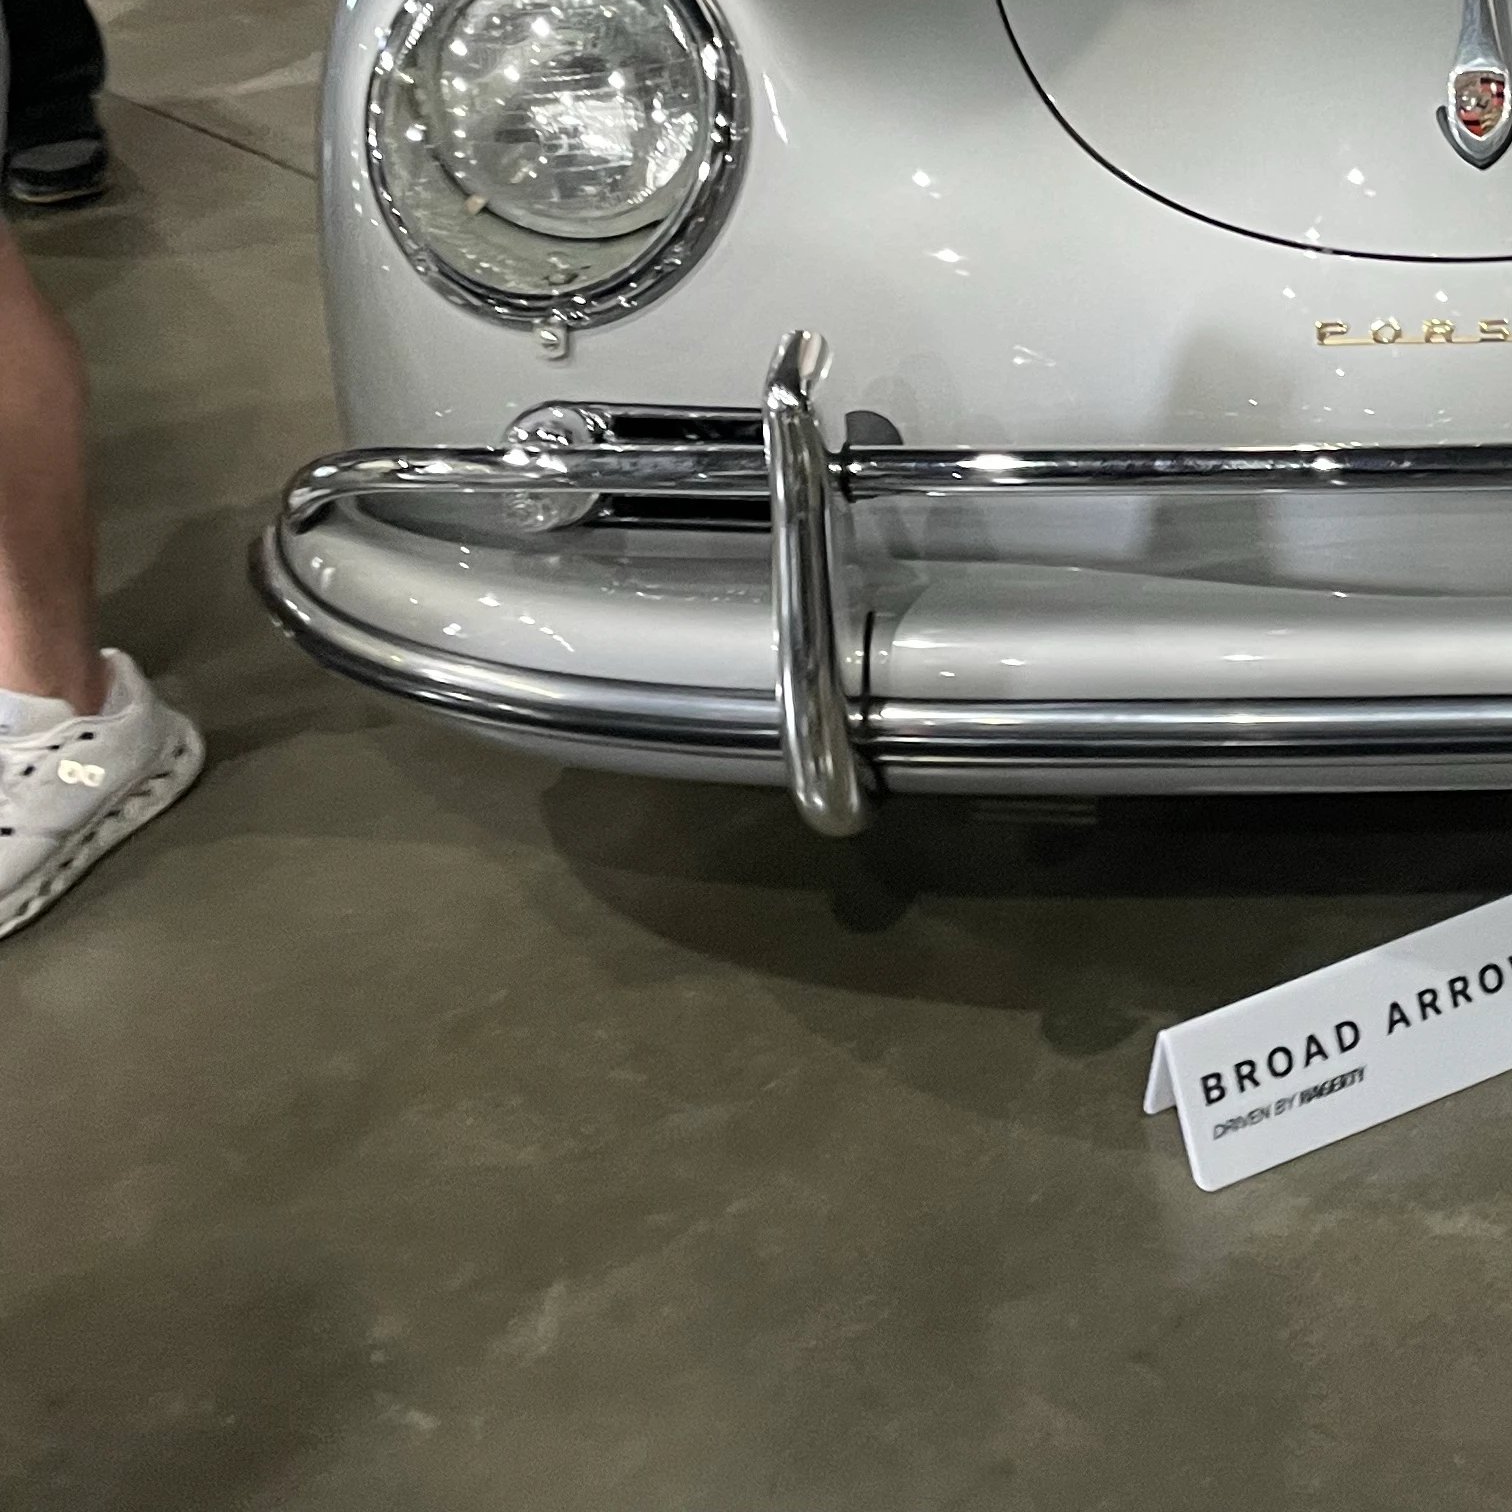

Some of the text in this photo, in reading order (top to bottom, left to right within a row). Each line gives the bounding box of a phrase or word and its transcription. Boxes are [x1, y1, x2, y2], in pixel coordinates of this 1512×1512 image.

[1200, 1019, 1361, 1107] BROAD
[1213, 1104, 1272, 1141] DRIVEN
[1274, 1091, 1300, 1116] BY
